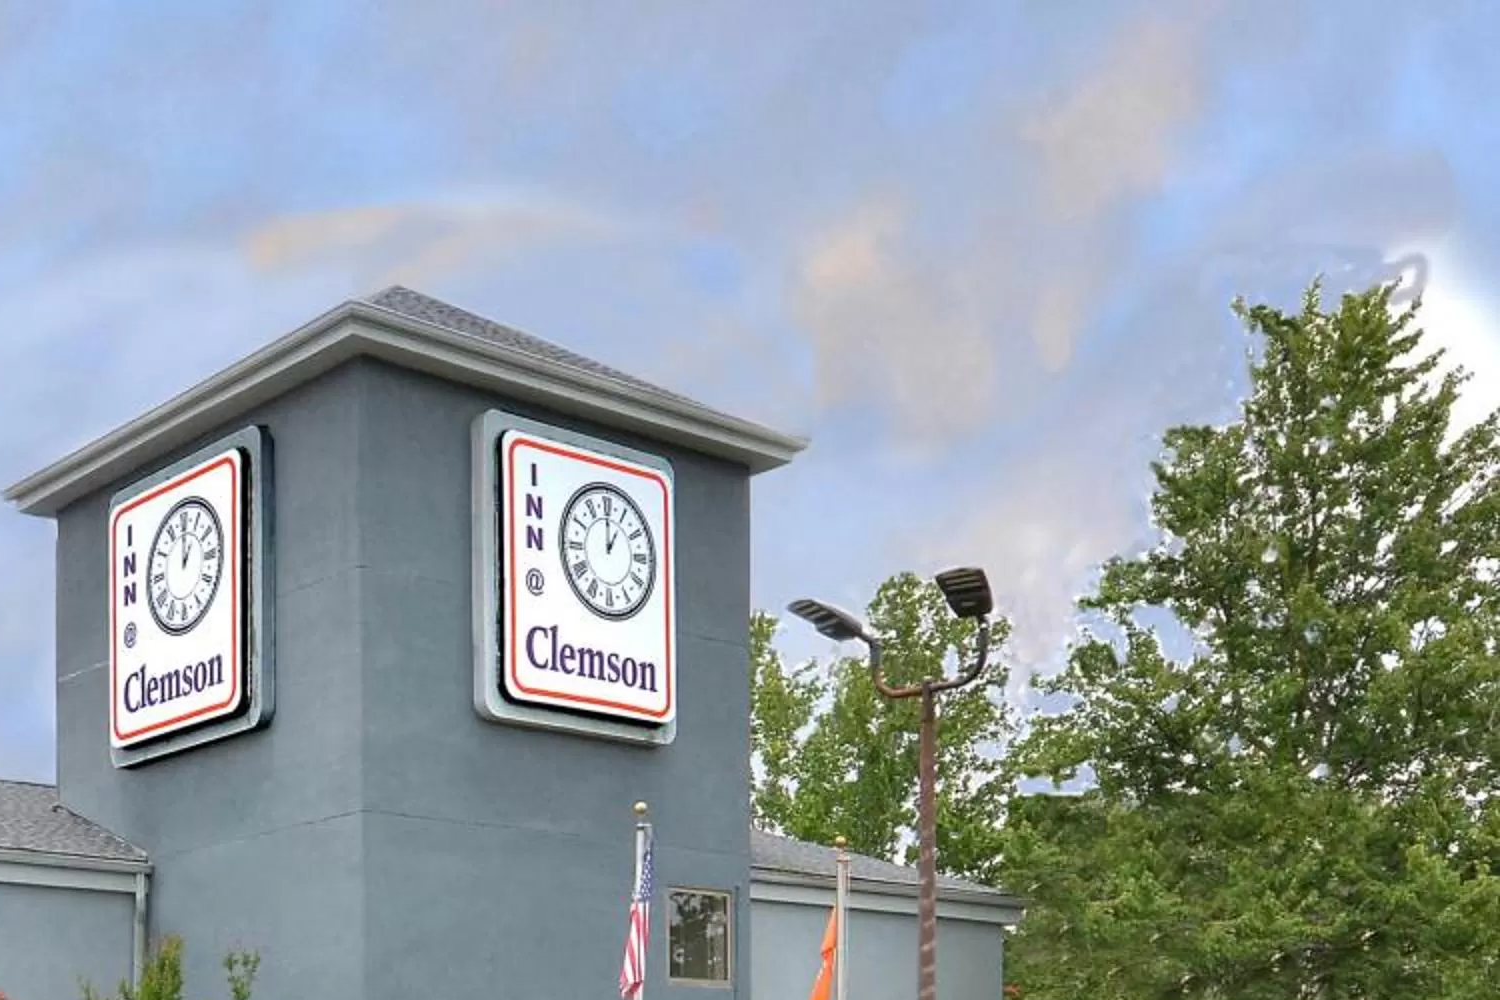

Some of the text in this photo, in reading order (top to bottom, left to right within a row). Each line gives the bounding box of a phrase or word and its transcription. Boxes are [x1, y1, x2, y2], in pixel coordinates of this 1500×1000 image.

[123, 525, 137, 607] INN
[525, 463, 545, 596] INN @
[123, 653, 225, 714] Clemson
[525, 624, 658, 693] Clemson
